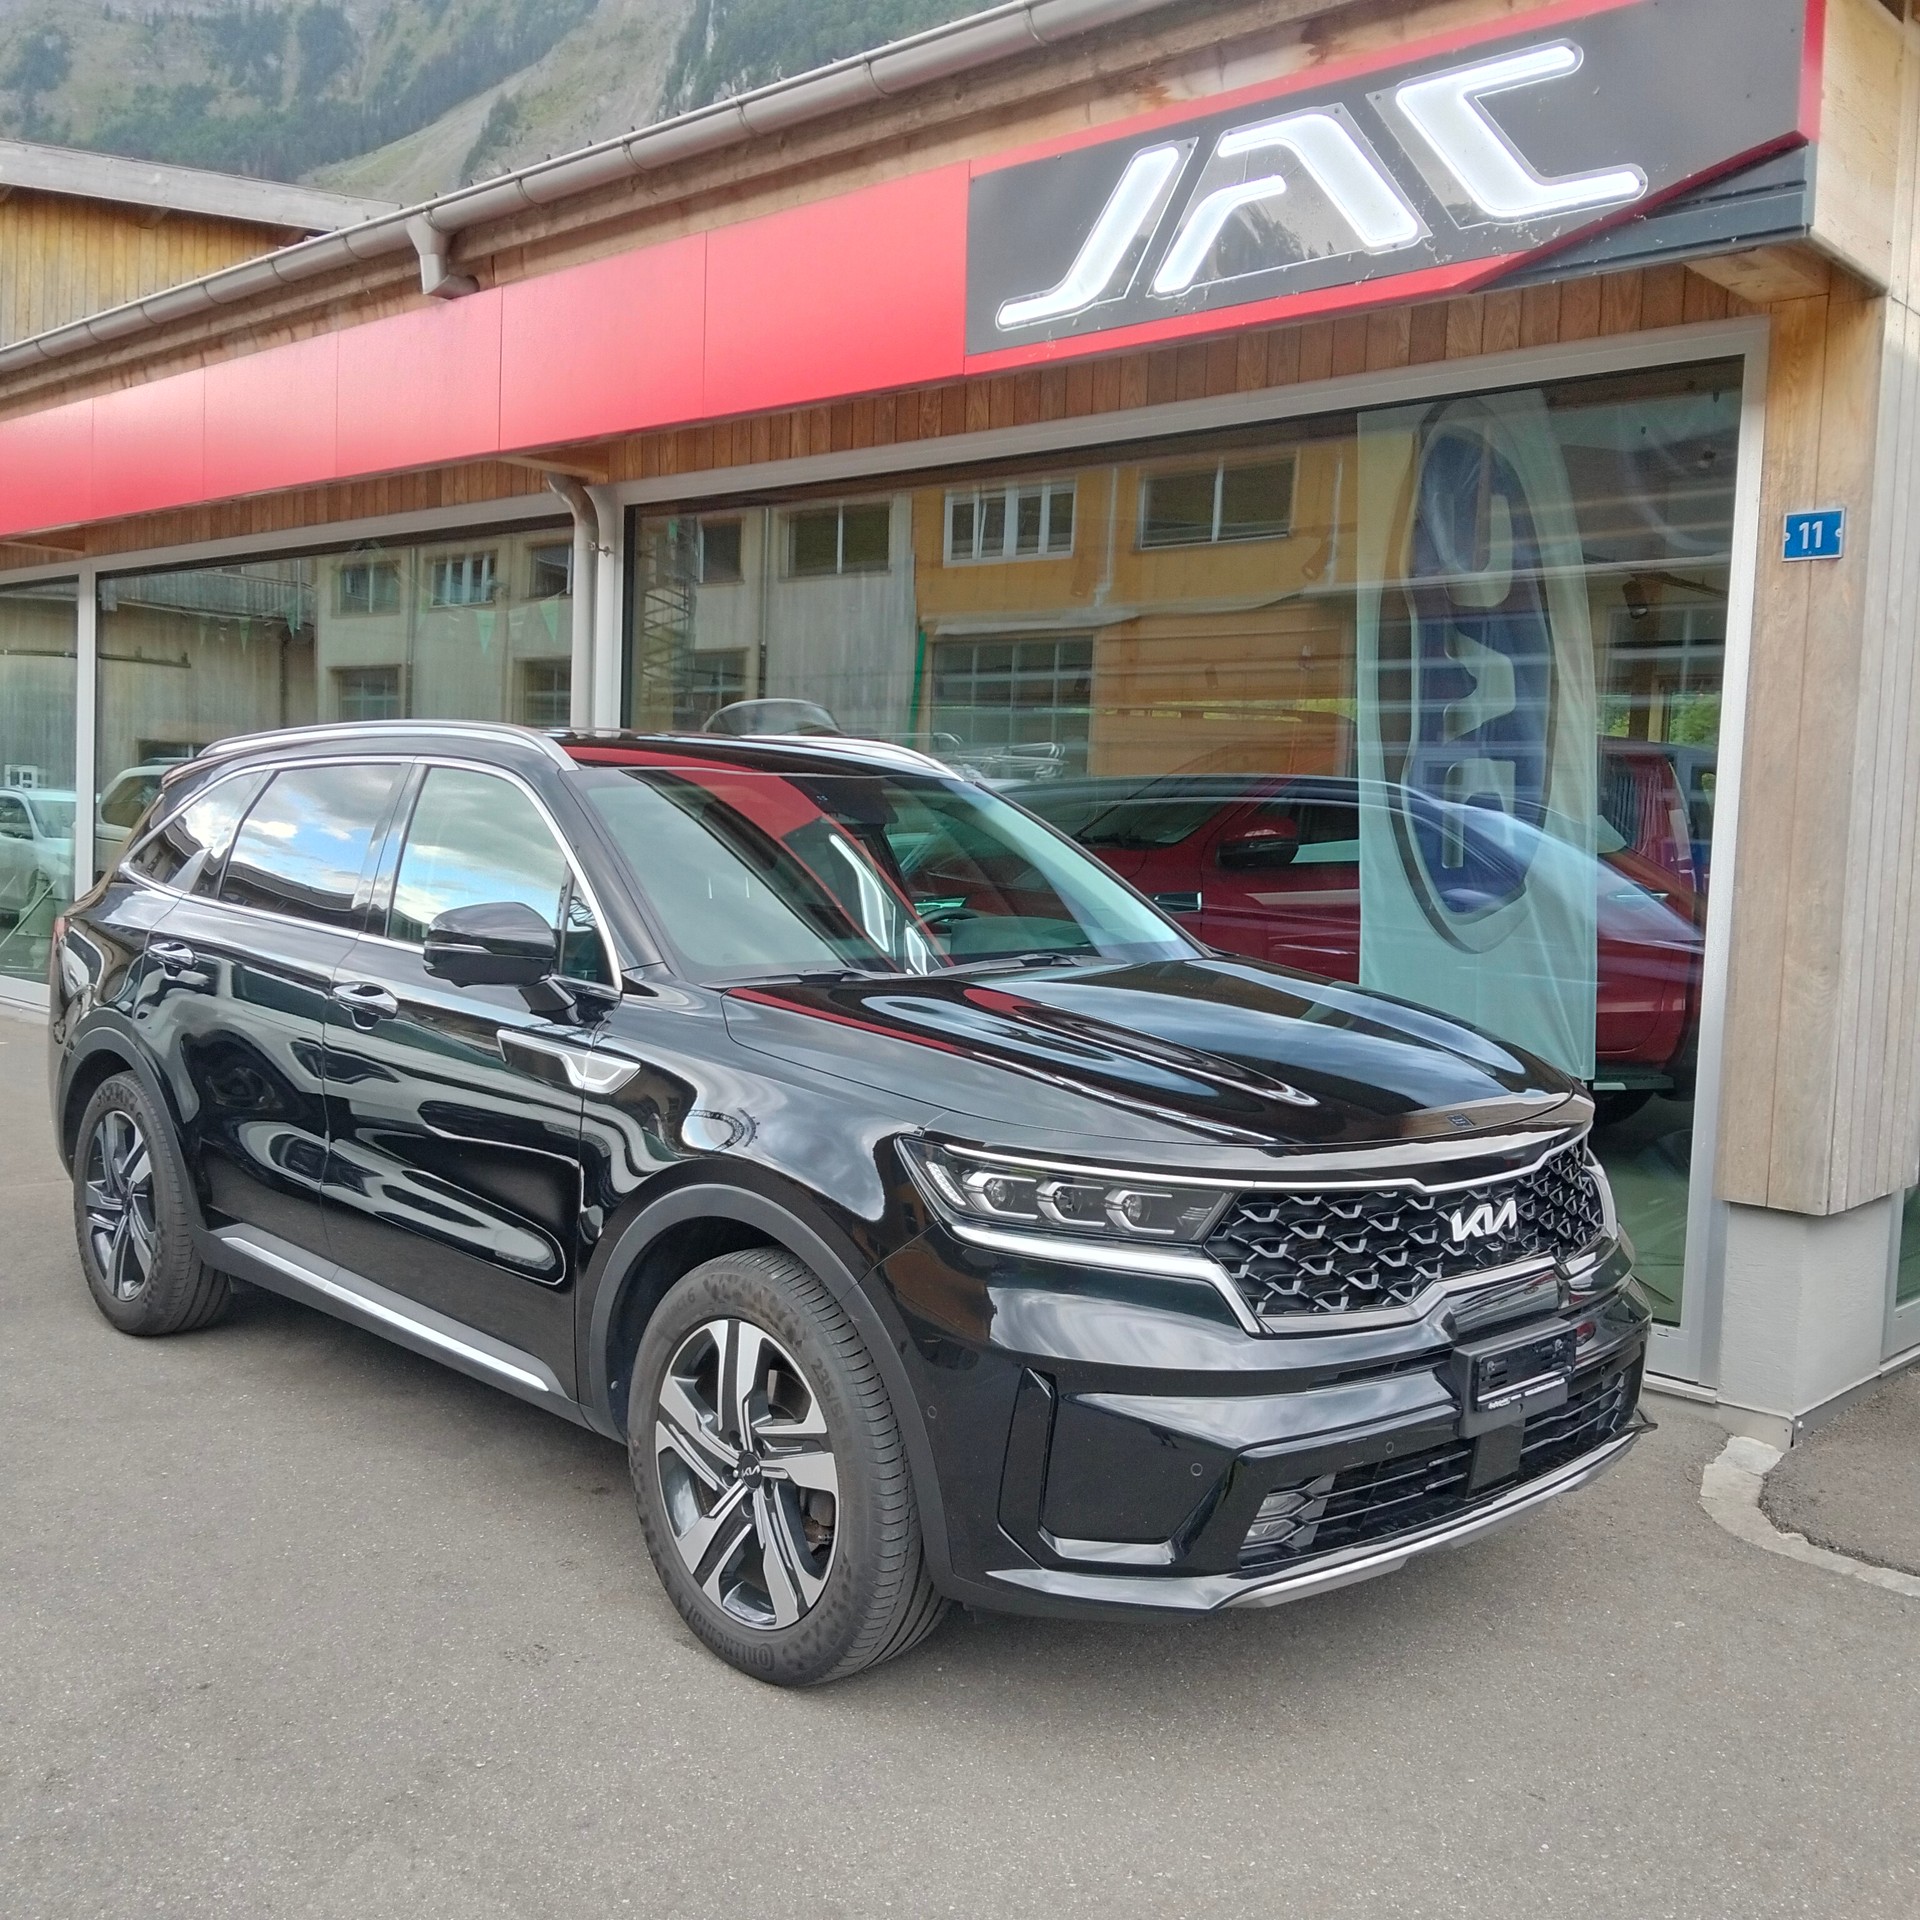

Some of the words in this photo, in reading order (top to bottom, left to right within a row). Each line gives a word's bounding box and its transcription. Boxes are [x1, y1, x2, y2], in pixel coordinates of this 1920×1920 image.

[998, 38, 1648, 330] JAC
[1798, 520, 1824, 550] 11
[1450, 1197, 1518, 1242] KIA
